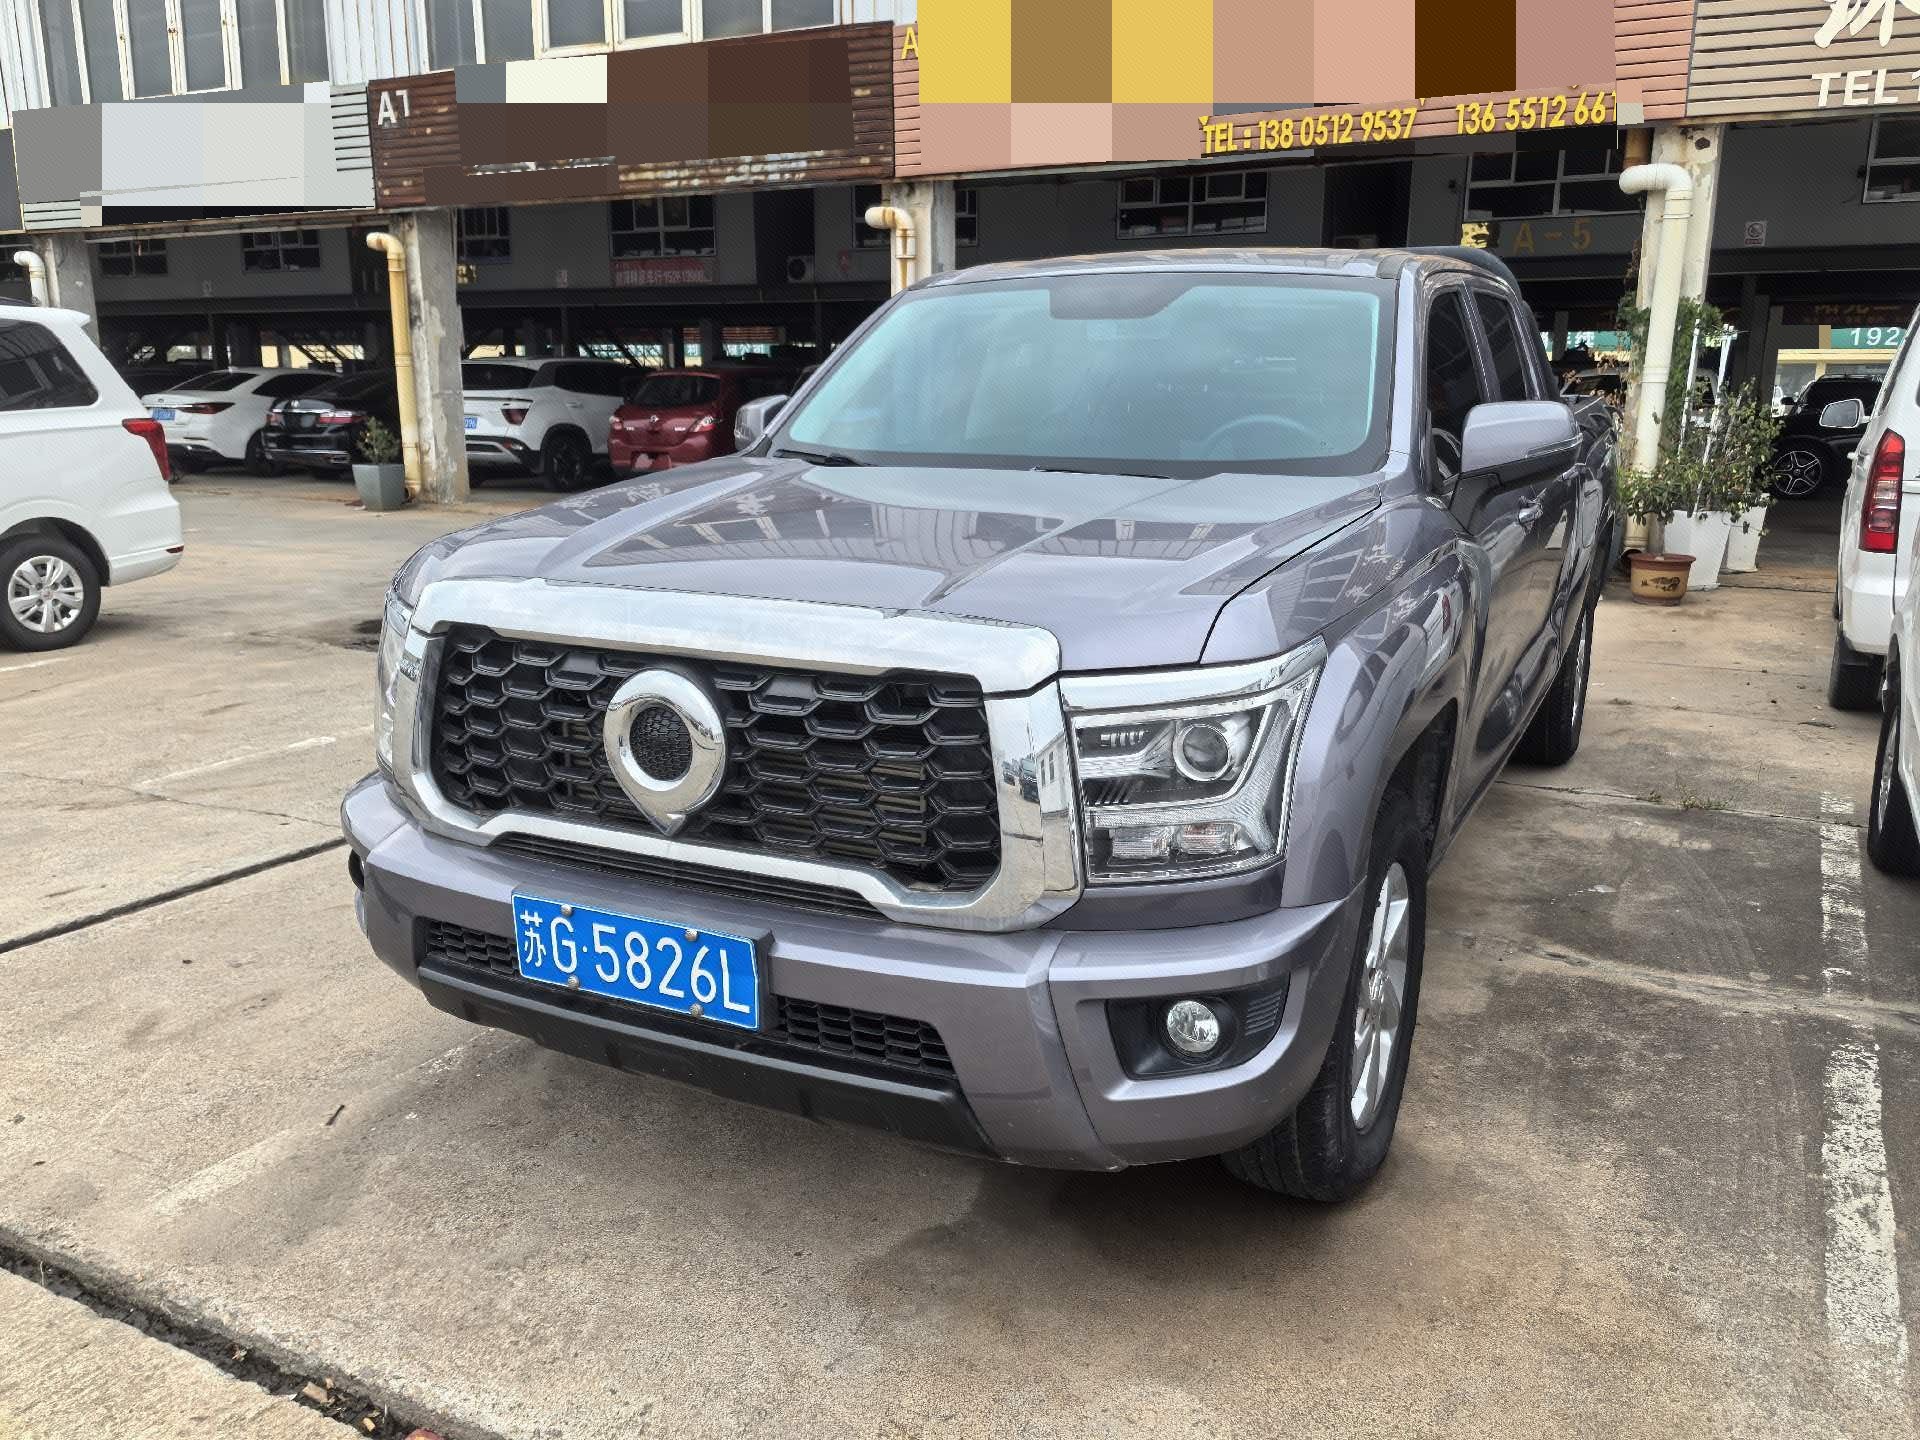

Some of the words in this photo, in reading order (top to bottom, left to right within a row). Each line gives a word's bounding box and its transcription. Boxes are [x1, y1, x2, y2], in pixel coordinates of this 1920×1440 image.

[1811, 68, 1899, 107] TEL
[1258, 117, 1294, 150] 138
[1300, 112, 1353, 147] 0512
[1360, 107, 1418, 142] 9537
[1455, 101, 1496, 135] 136
[1504, 95, 1567, 131] 5512
[1851, 326, 1900, 346] 192
